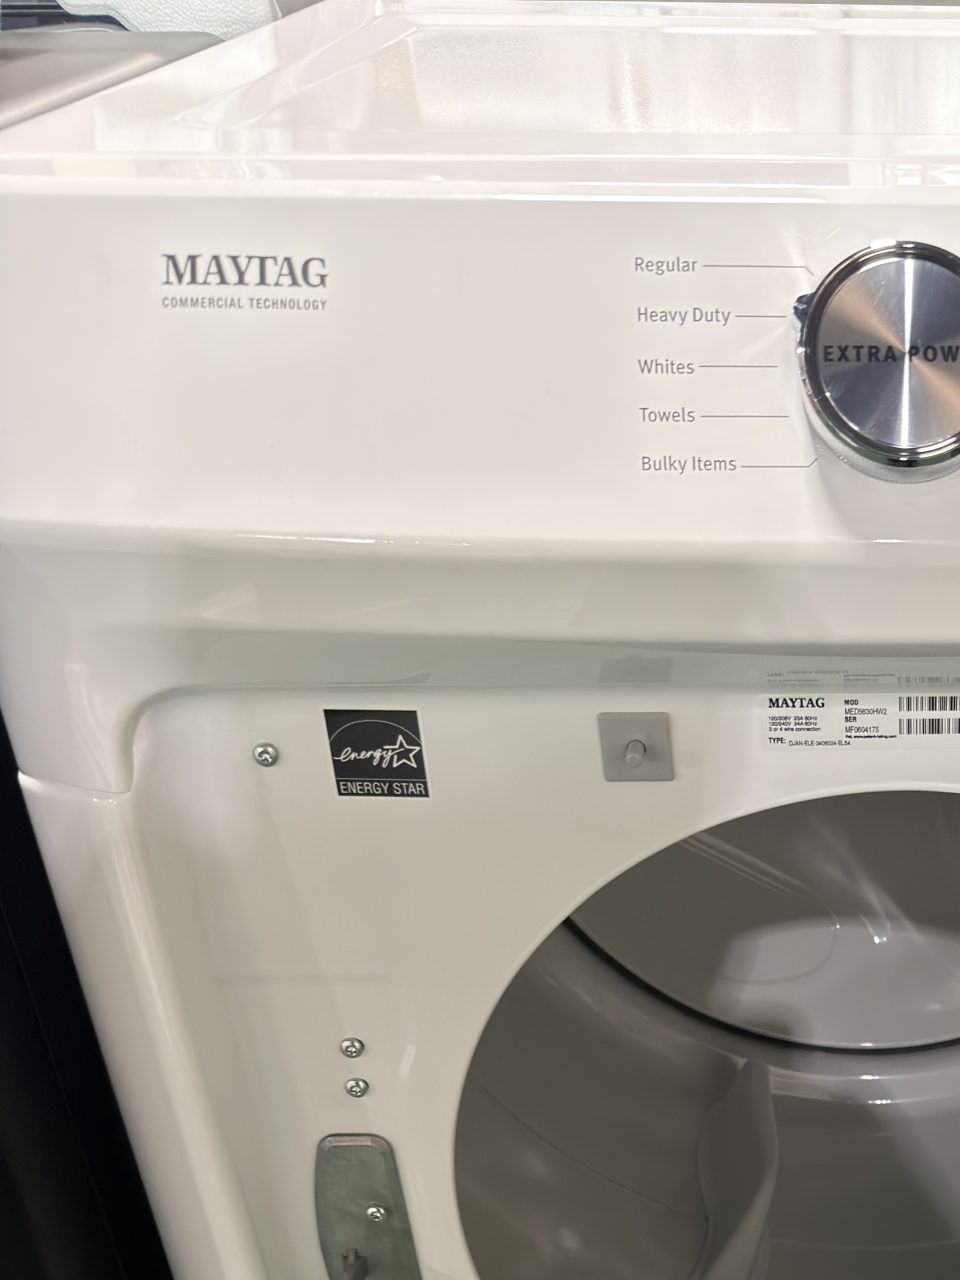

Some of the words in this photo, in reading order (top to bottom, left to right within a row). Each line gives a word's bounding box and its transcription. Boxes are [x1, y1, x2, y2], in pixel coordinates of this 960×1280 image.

[161, 253, 329, 288] MAYTAG
[634, 256, 698, 275] Regular
[161, 296, 244, 309] COMMERCIAL
[249, 297, 328, 311] TECHNOLOGY
[636, 307, 688, 327] Heavy
[692, 307, 732, 327] Duty
[822, 344, 898, 364] EXTRA
[637, 358, 696, 376] Whites
[639, 407, 696, 423] Towels
[641, 455, 688, 475] Bulky
[691, 455, 737, 472] Items
[768, 698, 825, 708] MAYTAG
[340, 782, 390, 794] ENERGY
[393, 782, 426, 795] STAR
